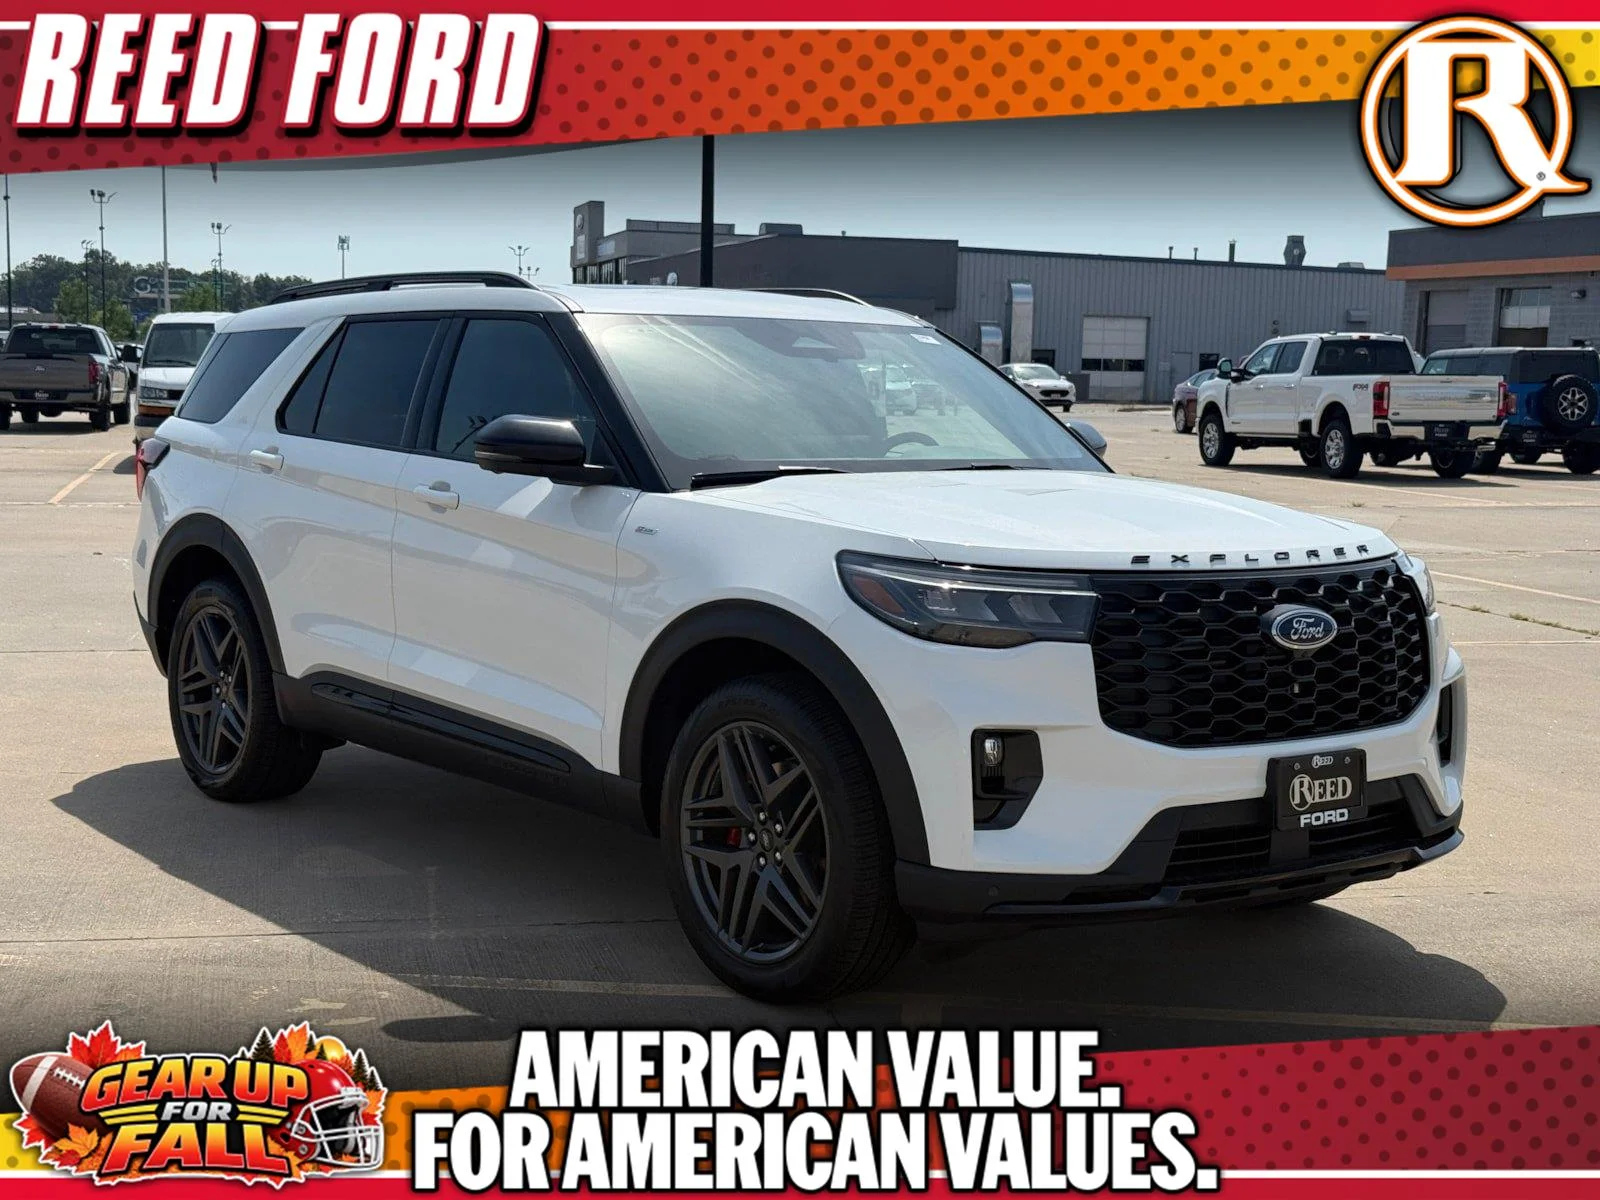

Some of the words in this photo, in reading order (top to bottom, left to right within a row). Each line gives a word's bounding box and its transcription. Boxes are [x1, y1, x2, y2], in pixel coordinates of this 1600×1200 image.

[1131, 544, 1369, 564] EXPLORER
[1290, 617, 1325, 640] Ford
[1312, 755, 1333, 768] REED
[1290, 774, 1352, 811] REED
[1300, 808, 1348, 828] FORD
